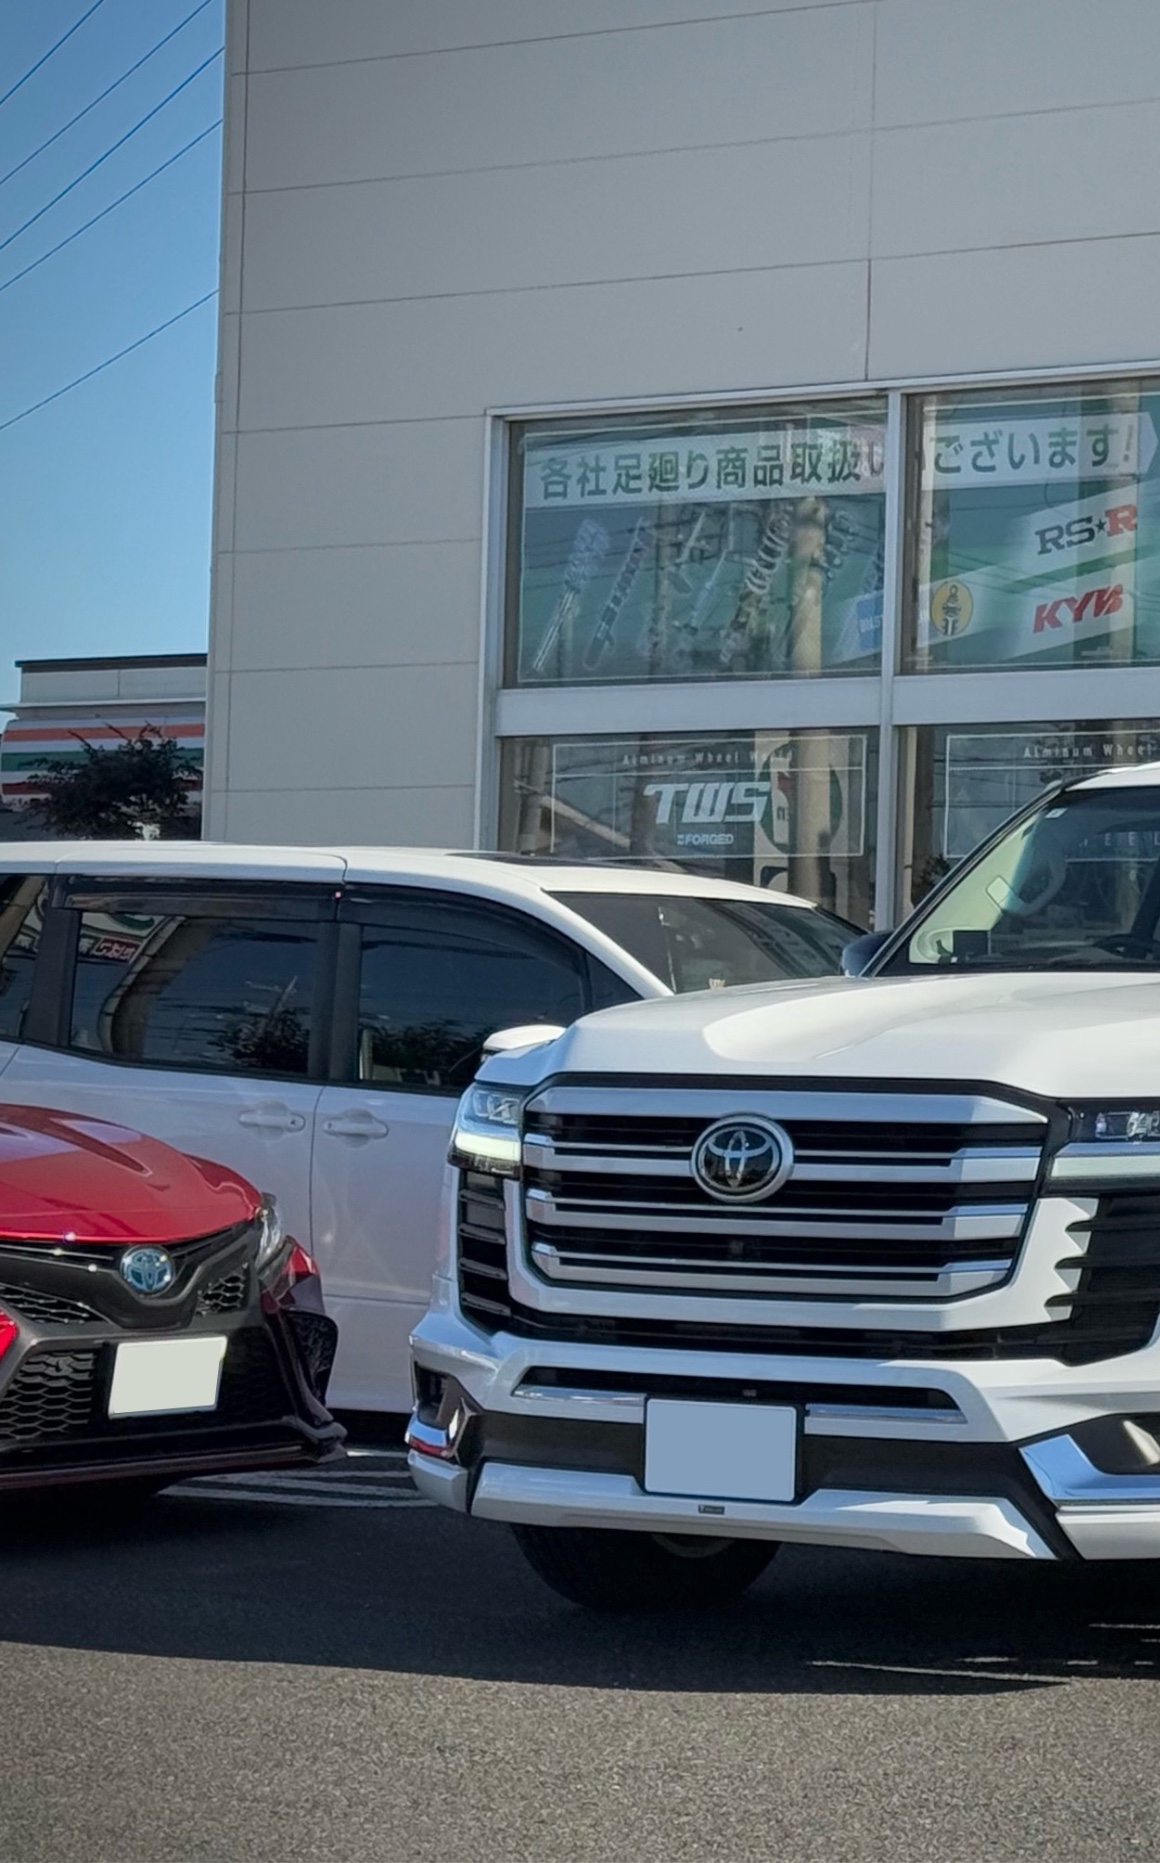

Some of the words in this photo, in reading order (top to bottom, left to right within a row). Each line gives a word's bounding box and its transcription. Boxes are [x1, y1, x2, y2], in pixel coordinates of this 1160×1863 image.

[1033, 584, 1124, 633] KYB
[1103, 743, 1151, 757] Wheel
[643, 781, 771, 824] TWS
